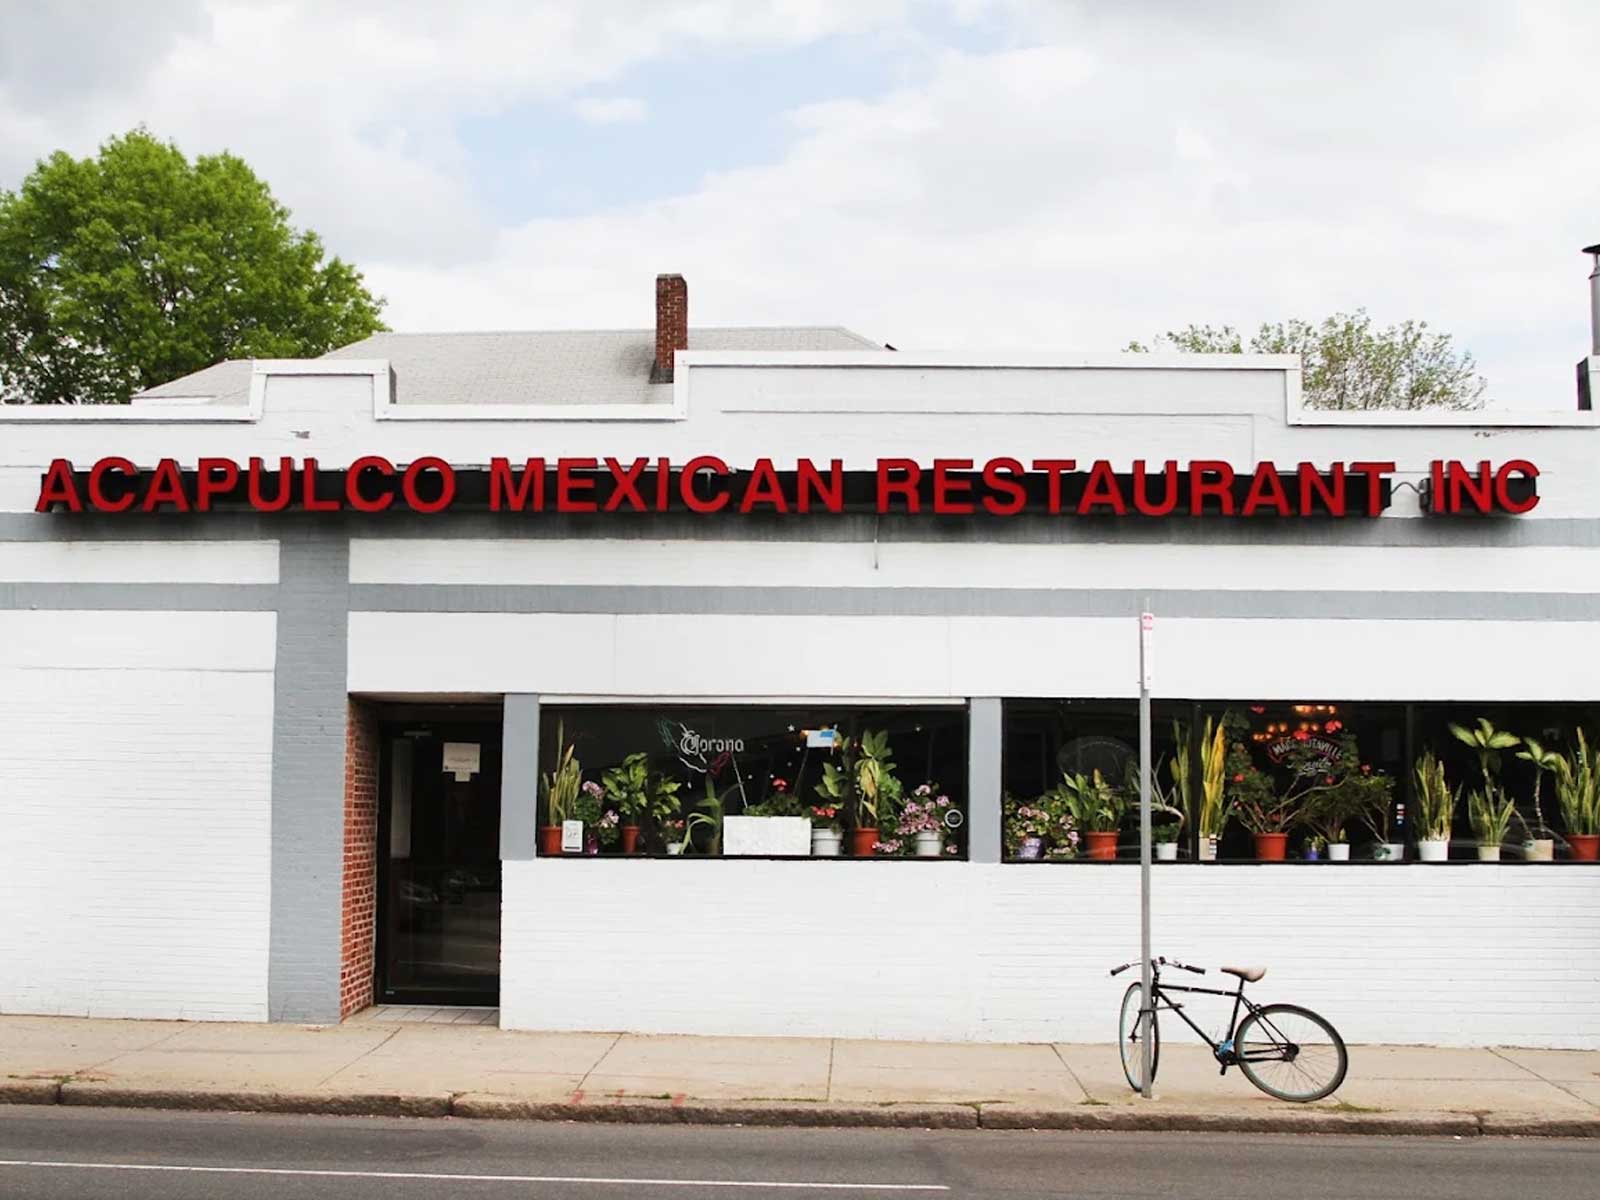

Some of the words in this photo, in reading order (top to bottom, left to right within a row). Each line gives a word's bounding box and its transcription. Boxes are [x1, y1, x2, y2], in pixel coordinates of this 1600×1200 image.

[37, 456, 455, 513] ACAPULCO
[490, 456, 843, 513] MEXICAN
[877, 457, 1394, 516] RESTAURANT
[1431, 460, 1540, 513] INC
[680, 729, 745, 755] Corona
